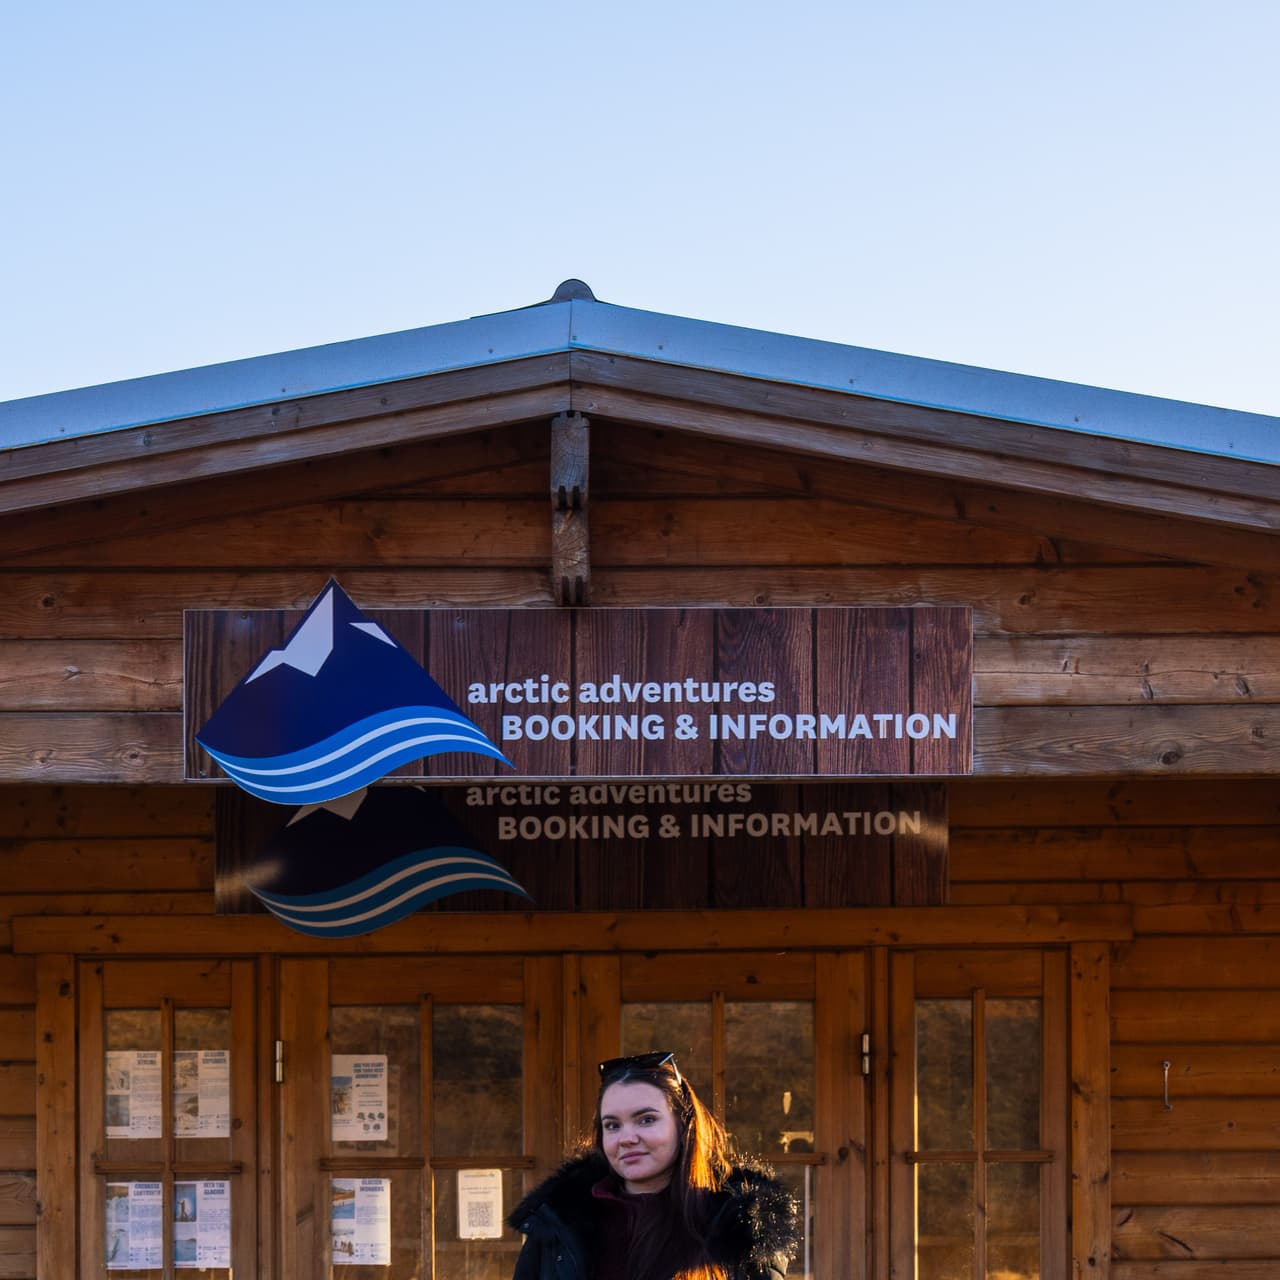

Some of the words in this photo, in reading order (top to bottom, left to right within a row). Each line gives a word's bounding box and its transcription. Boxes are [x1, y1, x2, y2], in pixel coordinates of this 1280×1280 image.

[467, 674, 570, 703] arctic
[578, 674, 776, 703] adventures
[501, 714, 665, 741] BOOKING
[674, 714, 699, 740] &
[709, 713, 957, 740] INFORMATION
[466, 784, 561, 806] arctic
[569, 783, 753, 805] adventures
[498, 814, 650, 841] BOOKING
[658, 814, 681, 838] &
[690, 811, 921, 838] INFORMATION
